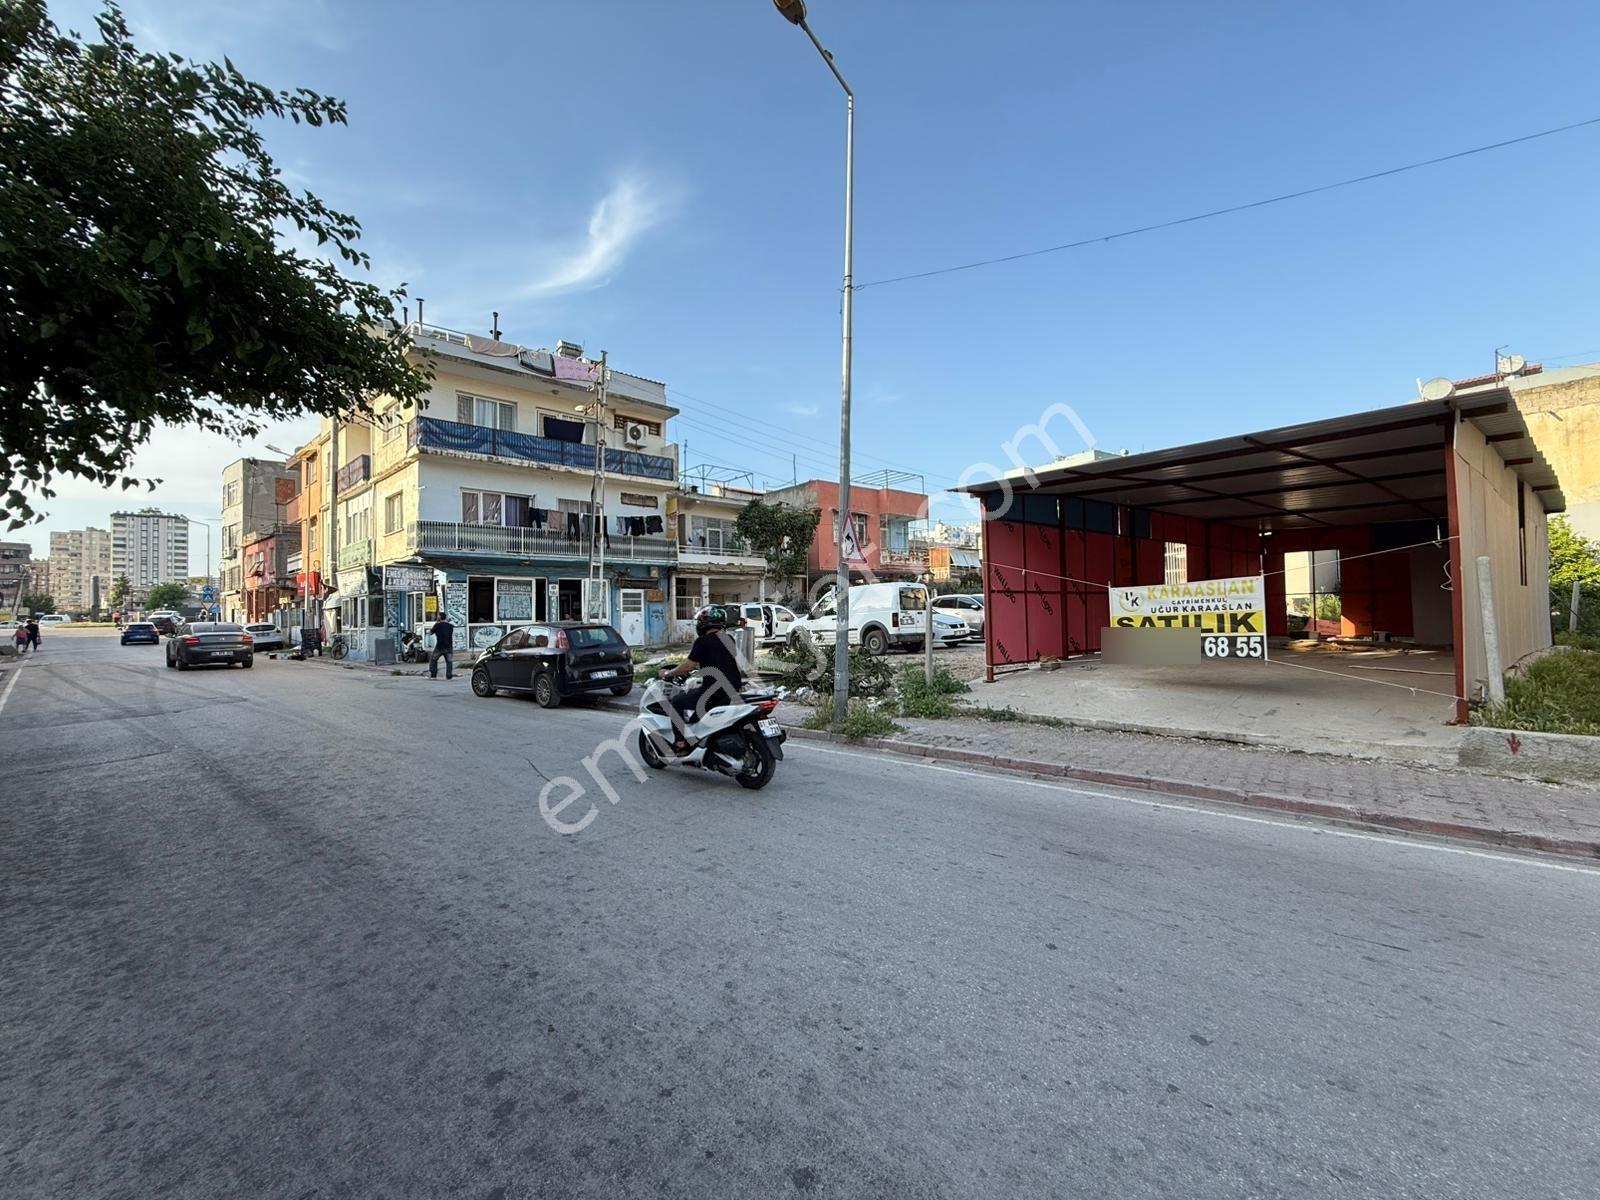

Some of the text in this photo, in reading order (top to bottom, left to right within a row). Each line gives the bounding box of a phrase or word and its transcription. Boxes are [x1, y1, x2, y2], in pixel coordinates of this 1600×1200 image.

[1147, 579, 1256, 600] KARAASLAN
[1150, 602, 1253, 614] UĞUR KARAASLAN
[1204, 636, 1262, 658] 68 55
